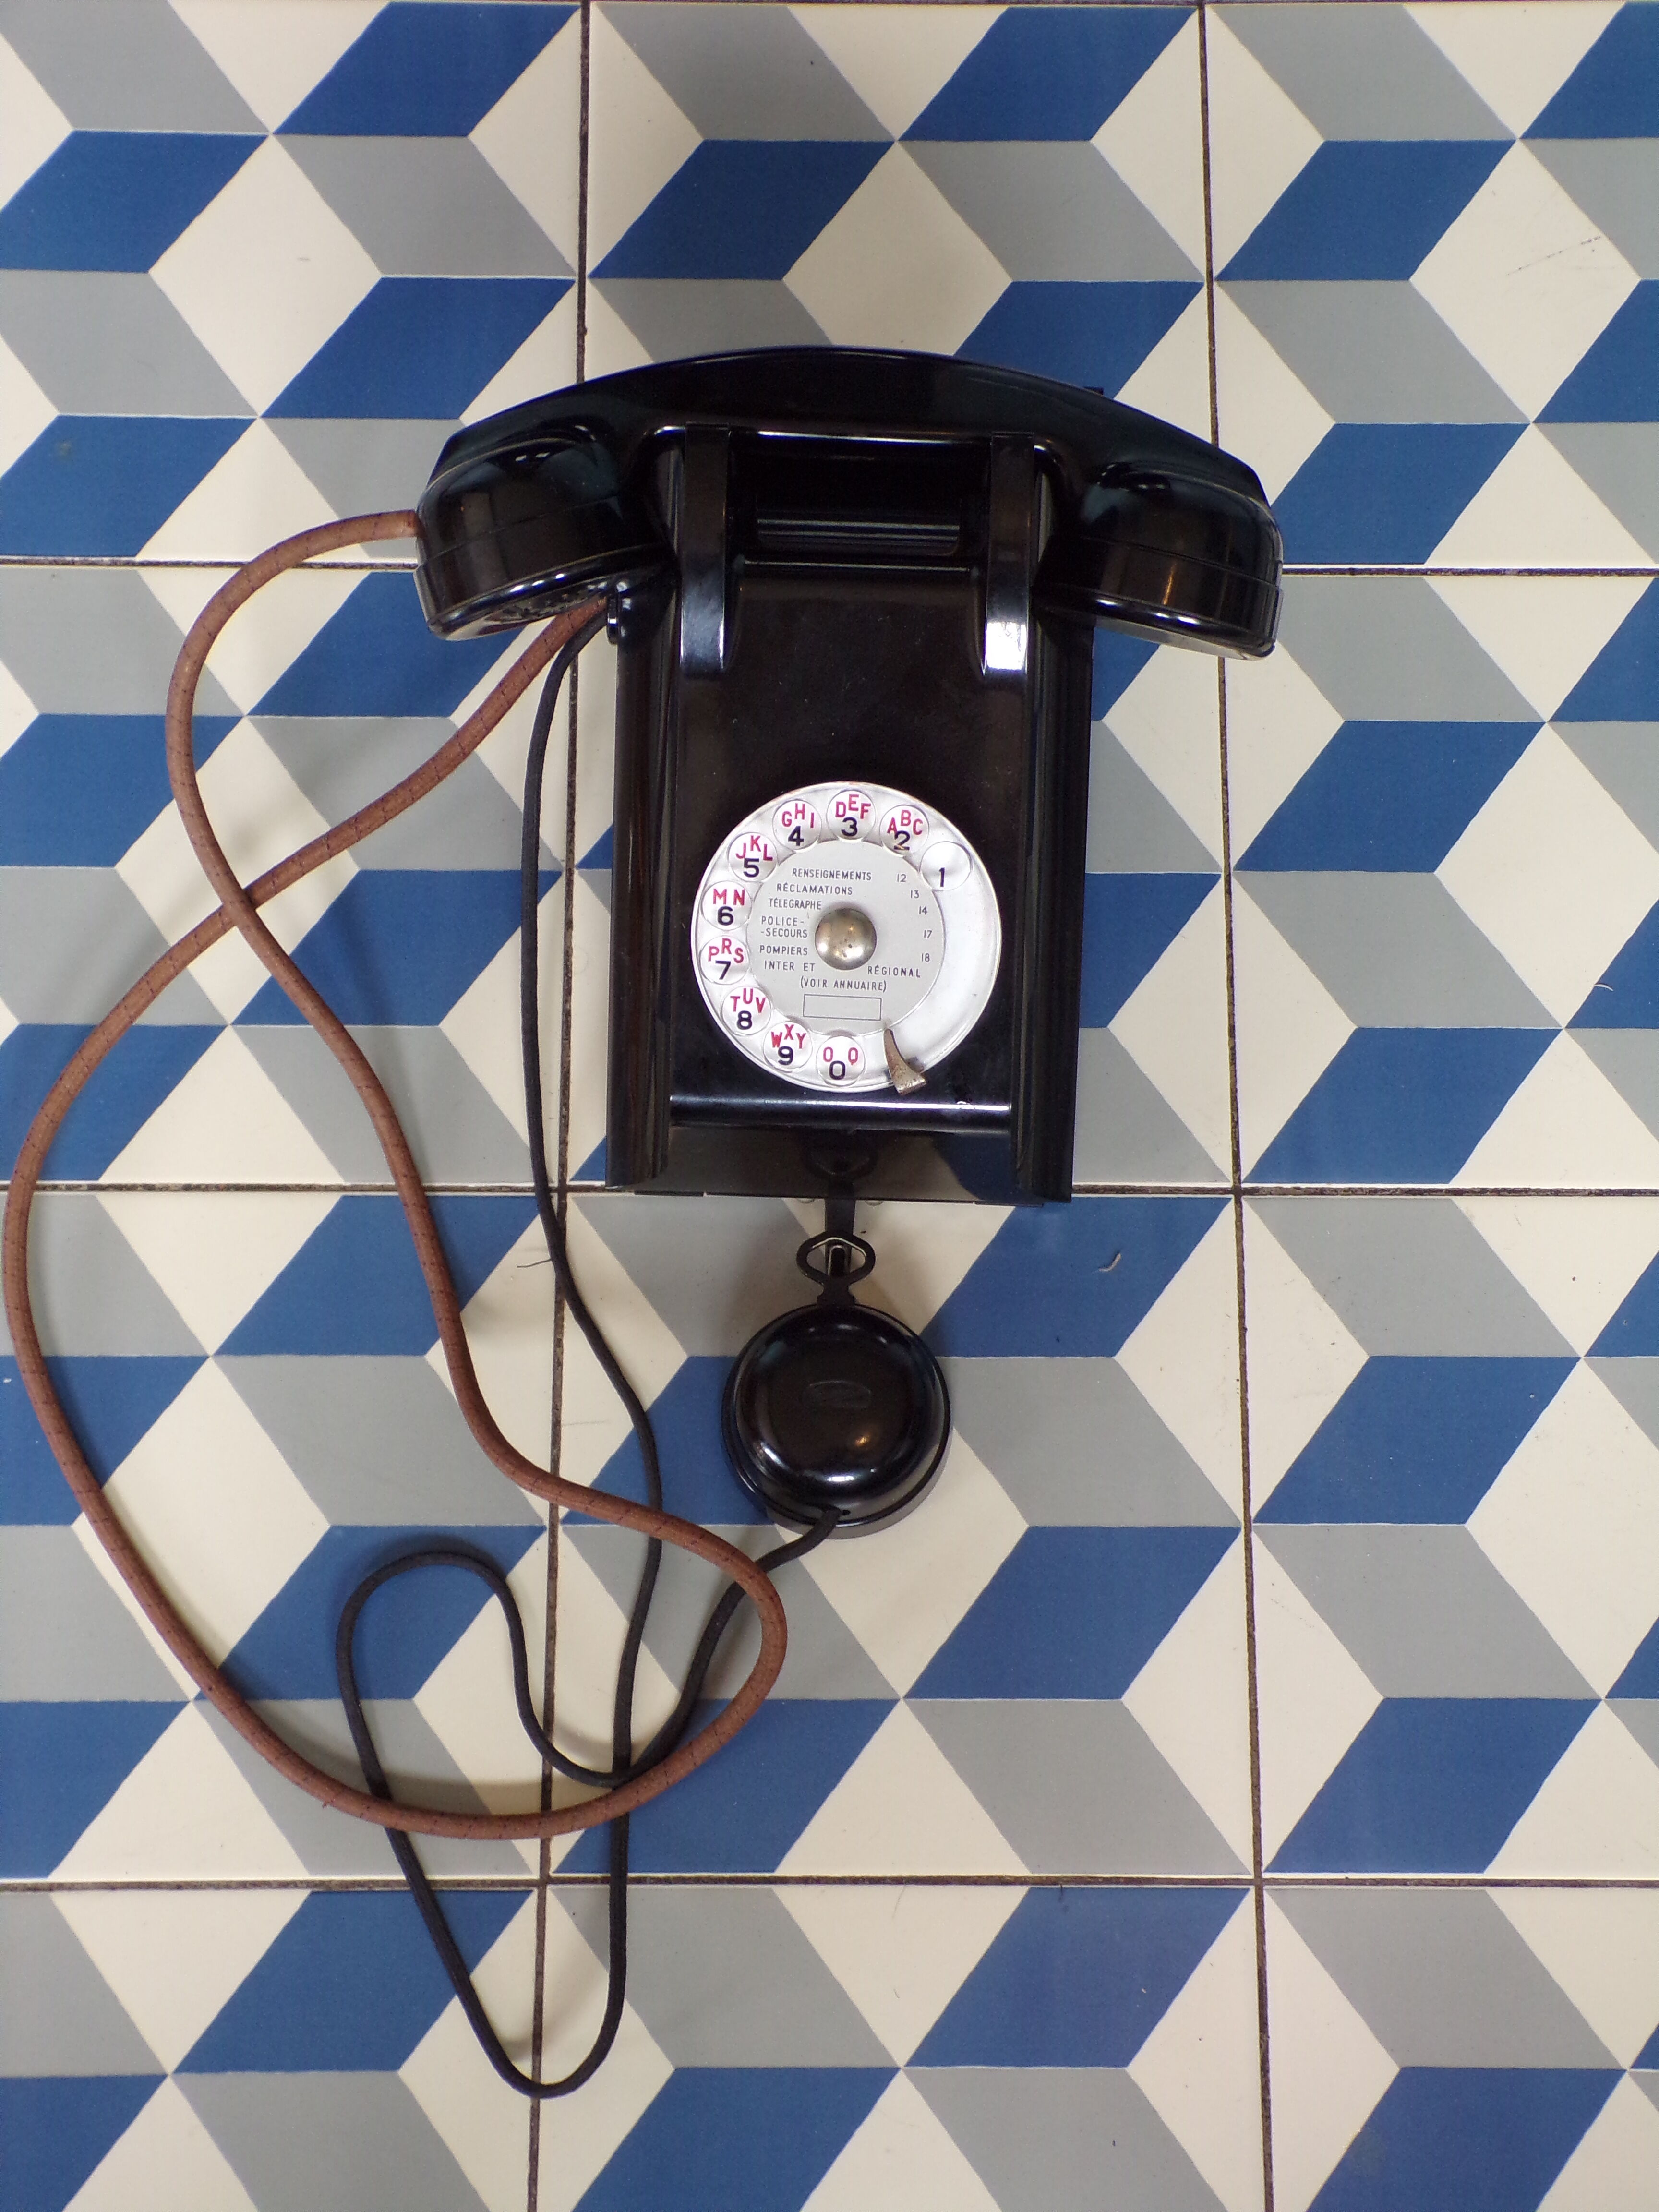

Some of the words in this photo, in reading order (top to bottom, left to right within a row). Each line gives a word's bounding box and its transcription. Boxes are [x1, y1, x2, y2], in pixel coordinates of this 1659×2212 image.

[788, 826, 804, 846] 4
[841, 817, 858, 837] 3
[893, 830, 910, 851] 2
[744, 858, 759, 878] 5
[792, 868, 871, 880] RENSEIGNEMENTS
[897, 874, 906, 882] 12
[939, 867, 945, 887] 1
[777, 882, 852, 895] RÉCLAMATIONS
[911, 890, 919, 898] 13
[717, 906, 734, 926] 6
[919, 906, 927, 915] 14
[924, 930, 932, 938] 17
[760, 945, 807, 955] POMPIERS
[922, 953, 930, 962] 18
[716, 961, 731, 980] 7
[765, 961, 794, 971] INTER
[804, 963, 815, 972] ET
[868, 965, 920, 978] RÉGIONAL
[801, 976, 827, 988] (VOIR
[834, 980, 886, 993] ANNUAIRE)
[737, 1010, 753, 1030] 8
[778, 1046, 793, 1065] 9
[829, 1061, 846, 1080] 0
